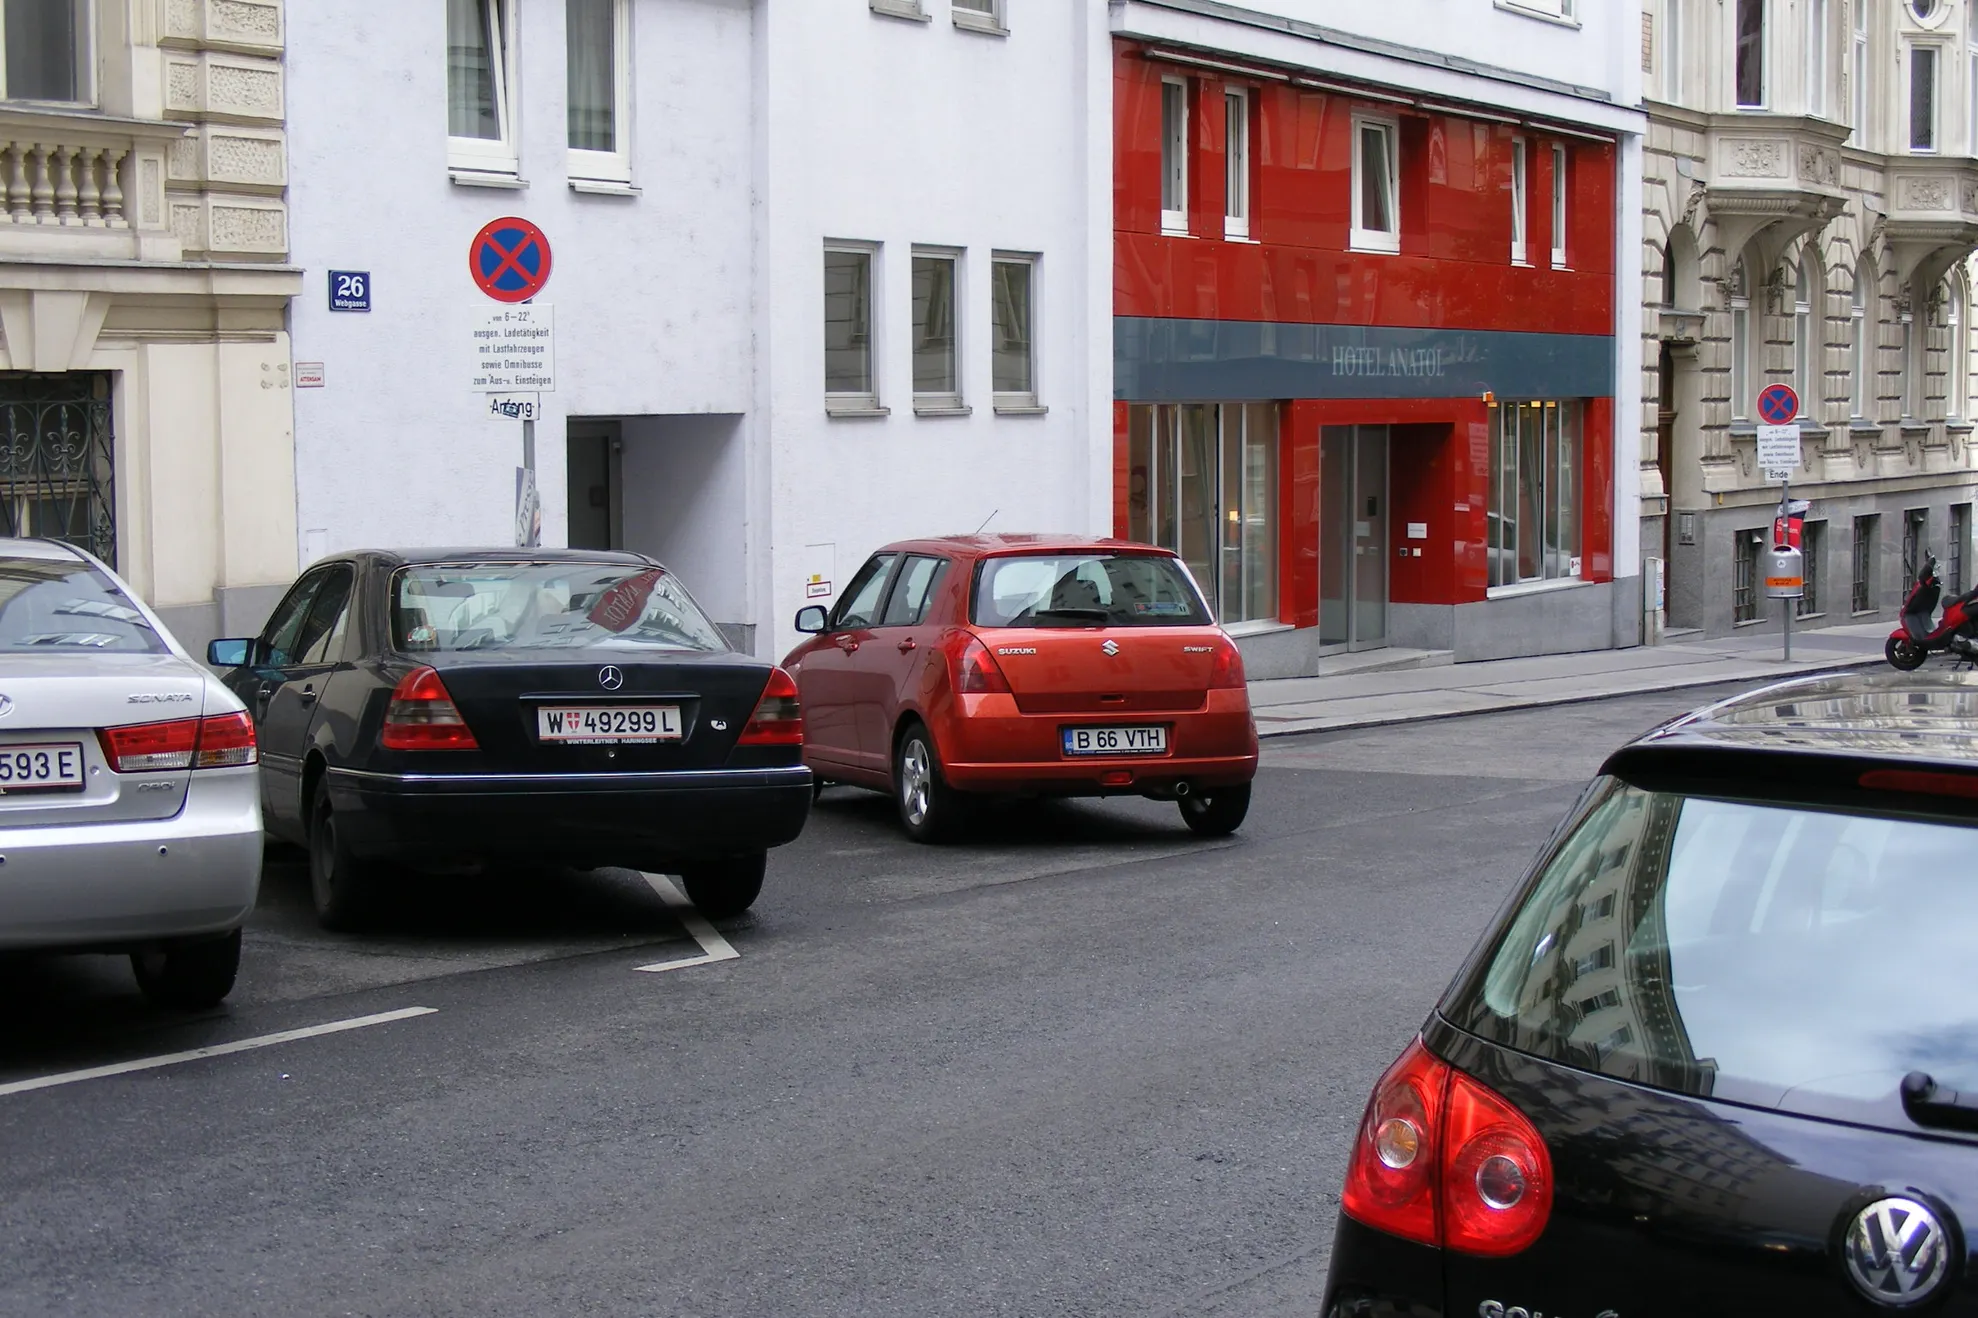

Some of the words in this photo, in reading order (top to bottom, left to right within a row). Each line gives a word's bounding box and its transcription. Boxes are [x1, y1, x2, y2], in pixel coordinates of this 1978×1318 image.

[338, 275, 364, 298] 26
[334, 299, 367, 309] Webgasse
[473, 330, 501, 339] ausgen.
[504, 328, 549, 339] Ladetätigkeit
[479, 344, 490, 353] mit
[493, 344, 545, 354] Lastfahrzeugen
[481, 360, 502, 369] sowie
[504, 360, 543, 369] Omnibusse
[1332, 346, 1385, 376] HOTEL
[1387, 348, 1445, 376] ANATOL
[515, 375, 552, 386] Einsteigen
[491, 398, 533, 418] Anng
[1769, 470, 1789, 479] Ende
[127, 692, 193, 704] SONATA
[547, 712, 563, 734] W
[585, 711, 656, 733] 49299
[662, 711, 674, 733] L
[1077, 731, 1090, 749] B
[1097, 730, 1118, 748] 66
[1125, 729, 1160, 747] VTH
[58, 751, 75, 778] E
